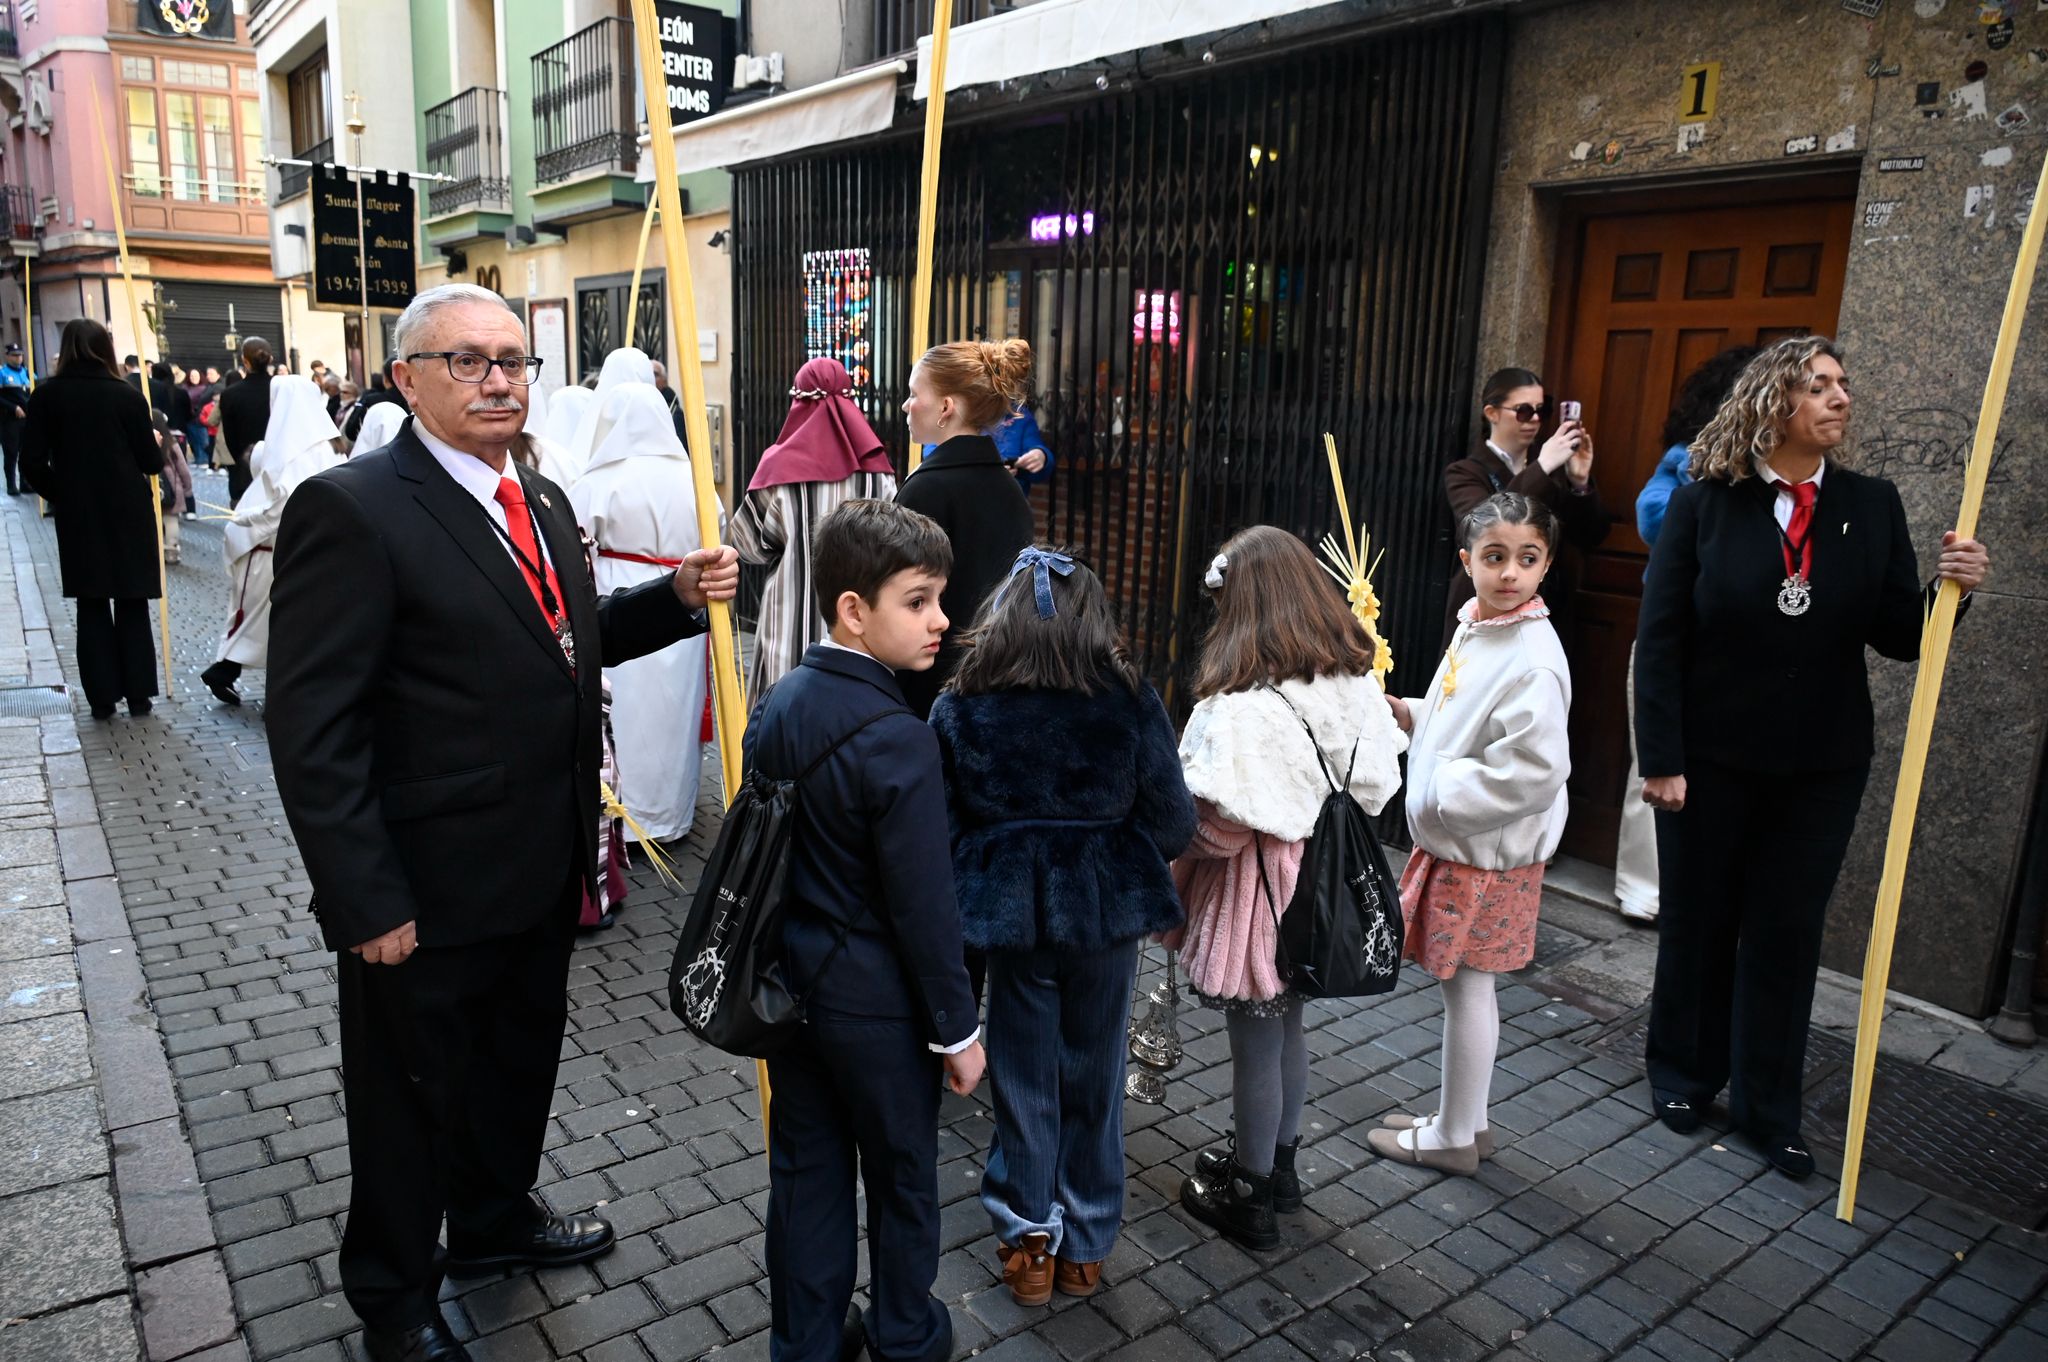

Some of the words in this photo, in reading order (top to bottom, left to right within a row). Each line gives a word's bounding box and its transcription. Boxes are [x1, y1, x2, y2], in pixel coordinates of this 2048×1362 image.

[667, 85, 710, 113] OOMS
[1685, 69, 1707, 117] 1
[1880, 158, 1923, 170] MOTIONLAB
[366, 198, 401, 213] Mayor
[321, 232, 360, 246] Seman
[374, 235, 408, 249] Santa
